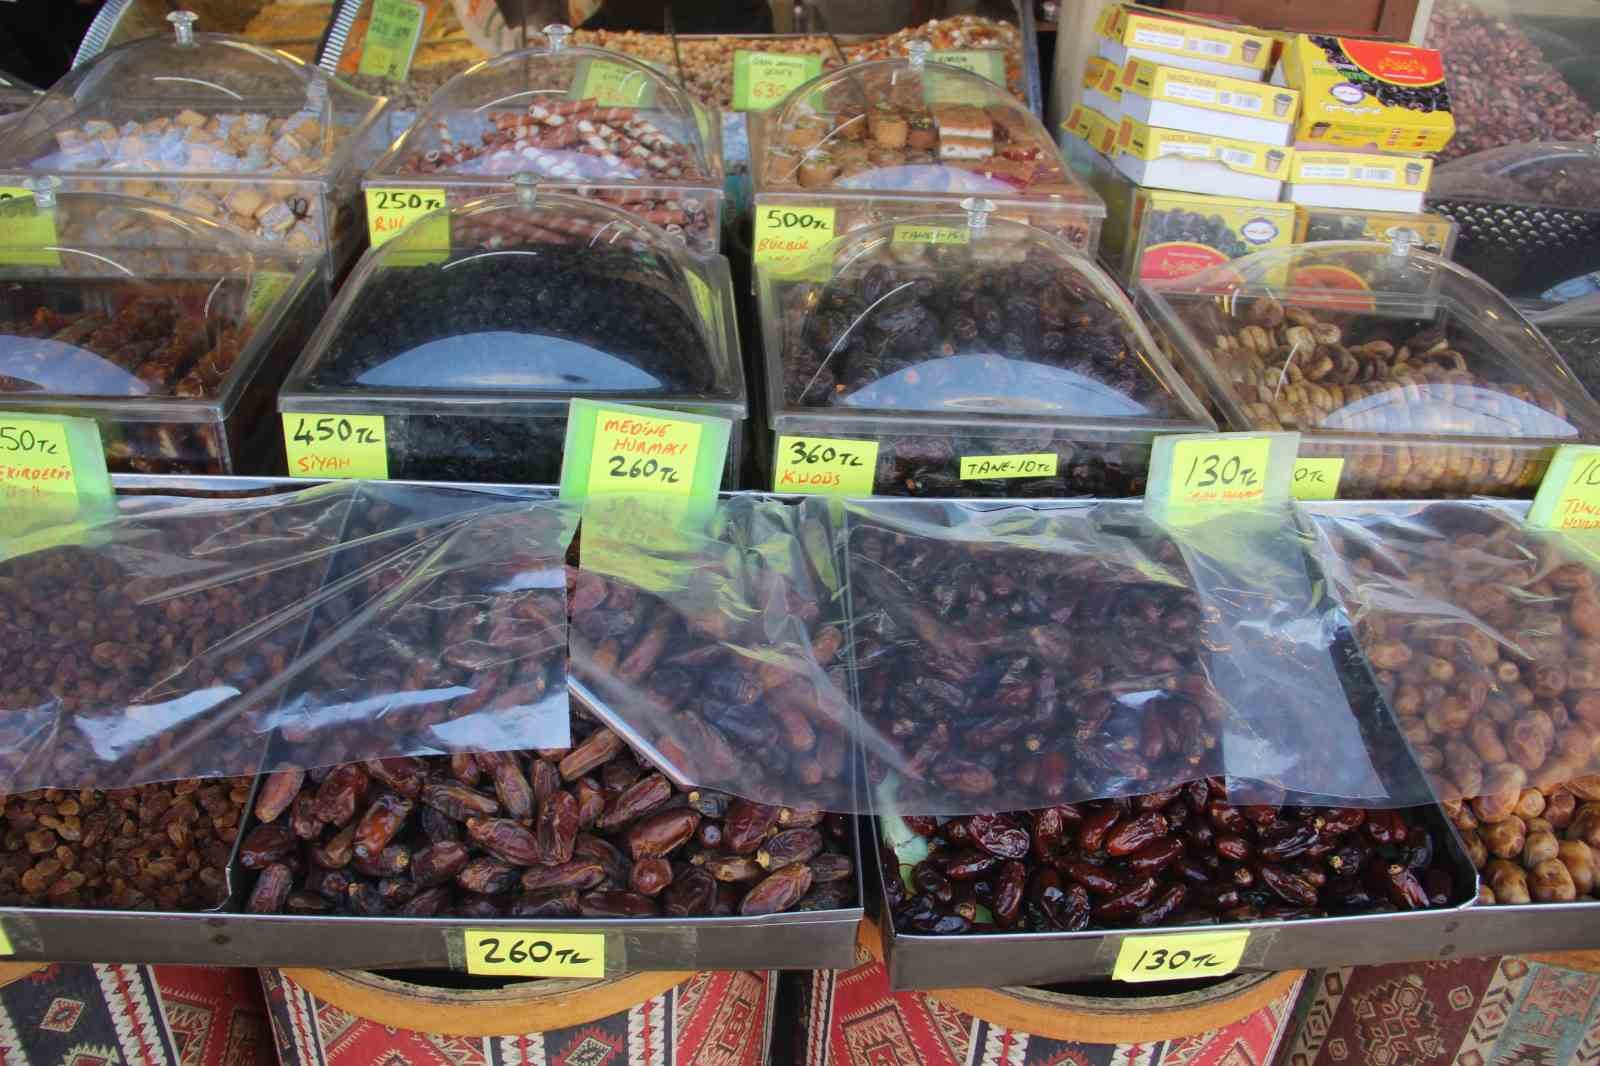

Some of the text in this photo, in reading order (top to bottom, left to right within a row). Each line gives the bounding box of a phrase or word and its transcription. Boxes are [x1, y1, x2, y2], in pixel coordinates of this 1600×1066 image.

[767, 209, 832, 231] 500TL
[0, 426, 58, 455] 50TL
[293, 418, 382, 446] 450TL
[790, 441, 865, 467] 360TL
[608, 455, 681, 484] 260TL
[1184, 453, 1259, 487] 130TL
[478, 937, 594, 964] 260TL
[1131, 948, 1224, 972] 130TL
